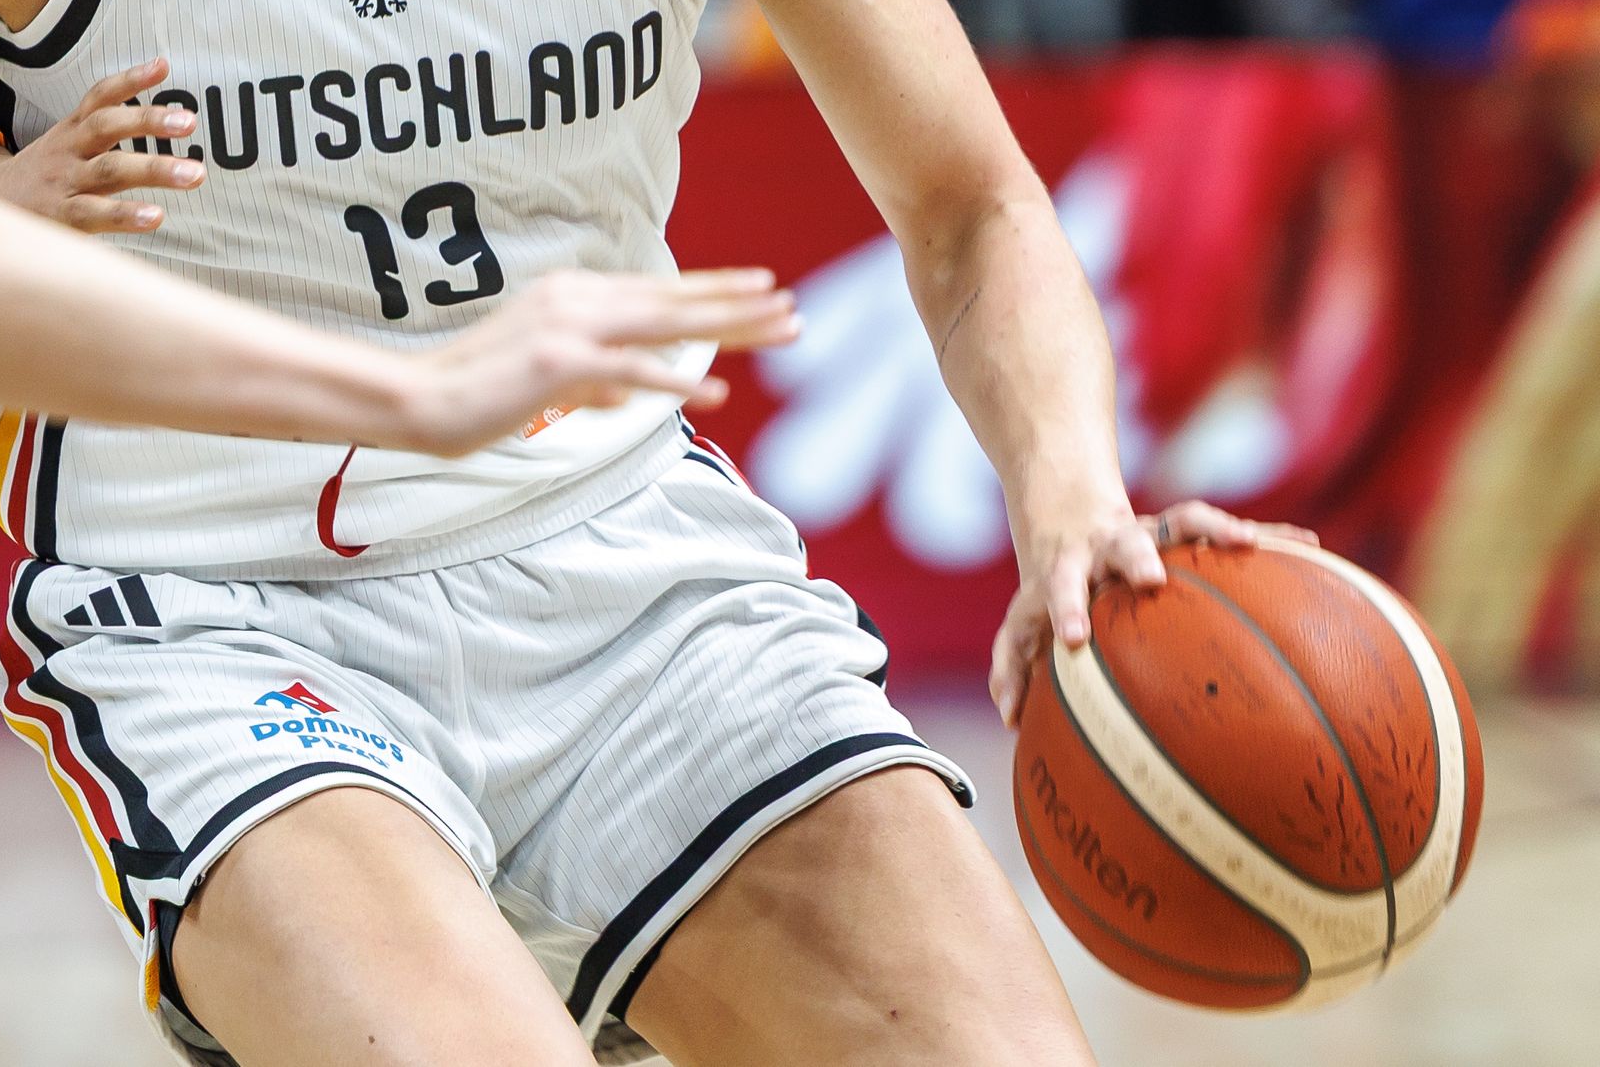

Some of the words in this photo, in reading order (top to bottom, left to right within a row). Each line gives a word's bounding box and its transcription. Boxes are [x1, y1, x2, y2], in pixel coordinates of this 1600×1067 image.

[343, 181, 505, 321] 13
[250, 716, 404, 763] Domino's
[297, 734, 390, 769] Pizza
[1029, 756, 1158, 921] molten
